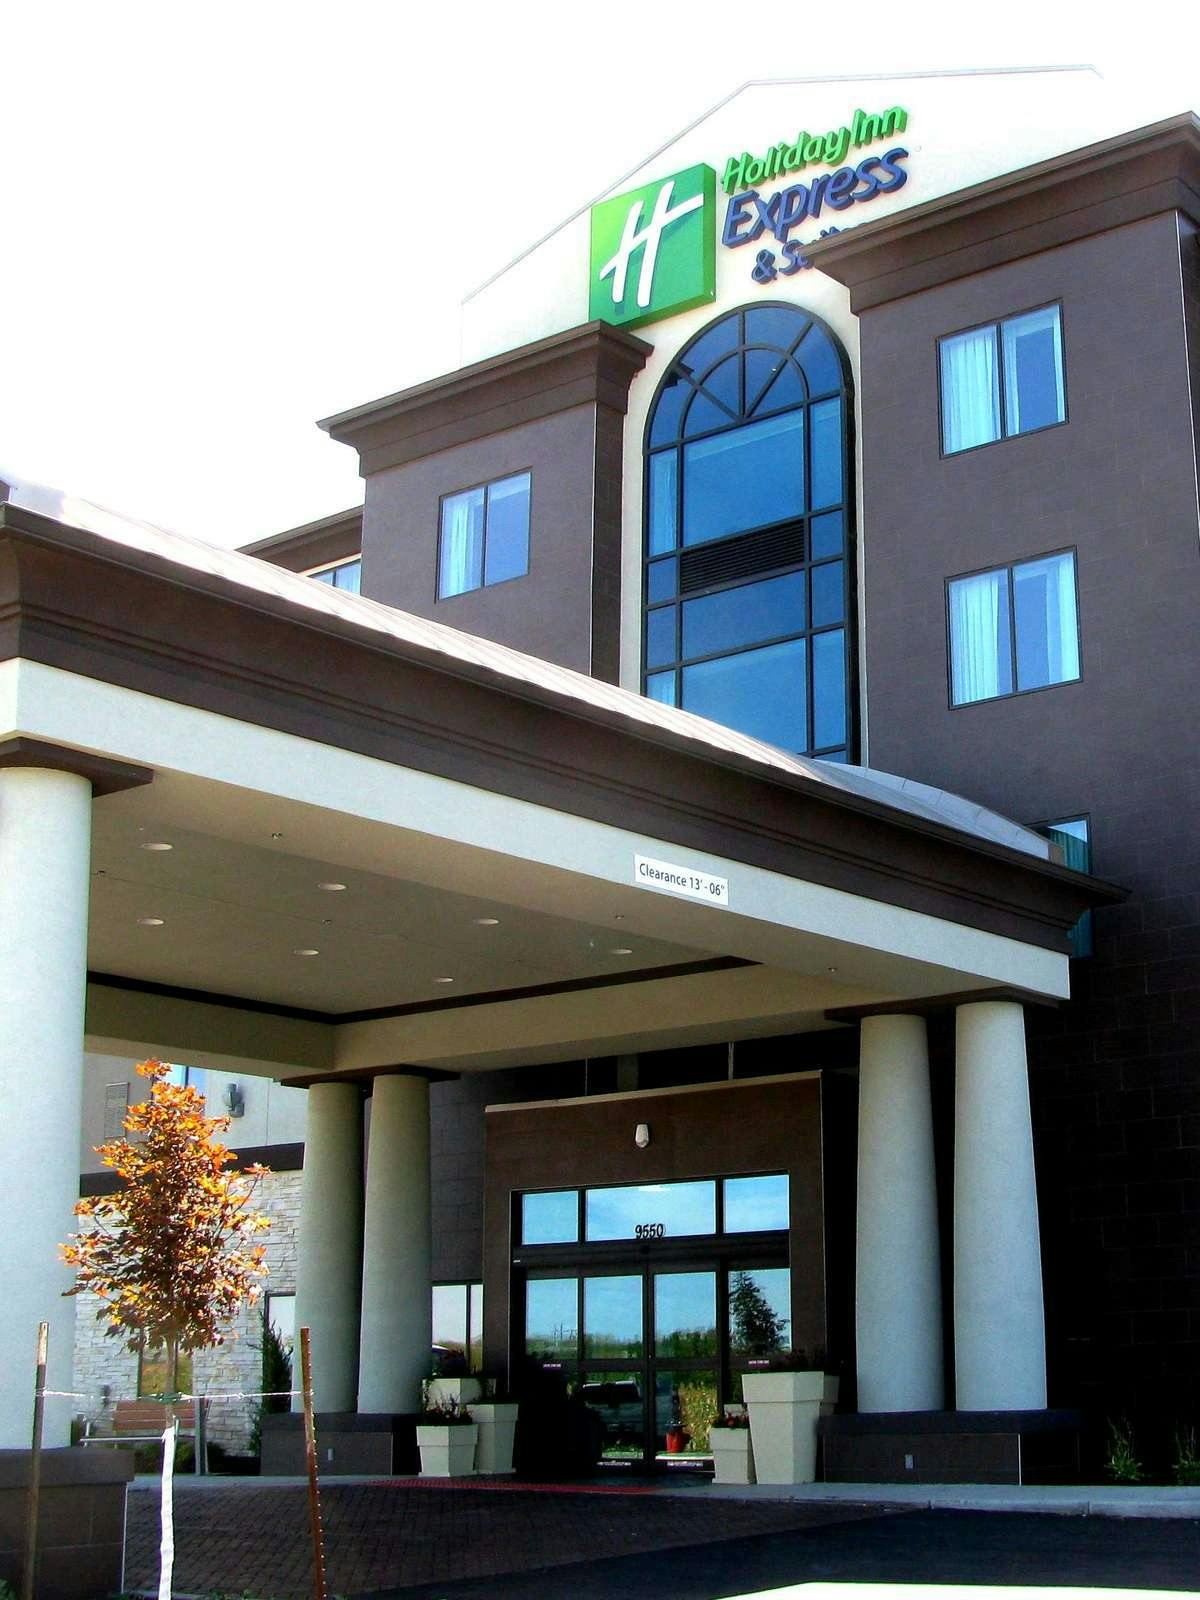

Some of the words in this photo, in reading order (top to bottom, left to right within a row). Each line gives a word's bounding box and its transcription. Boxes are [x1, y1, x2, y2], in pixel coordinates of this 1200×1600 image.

[722, 127, 850, 195] Holiday
[850, 106, 908, 149] Inn
[722, 147, 909, 249] Express
[751, 249, 778, 285] &
[639, 863, 687, 886] Clearance
[635, 1223, 664, 1240] 9550
